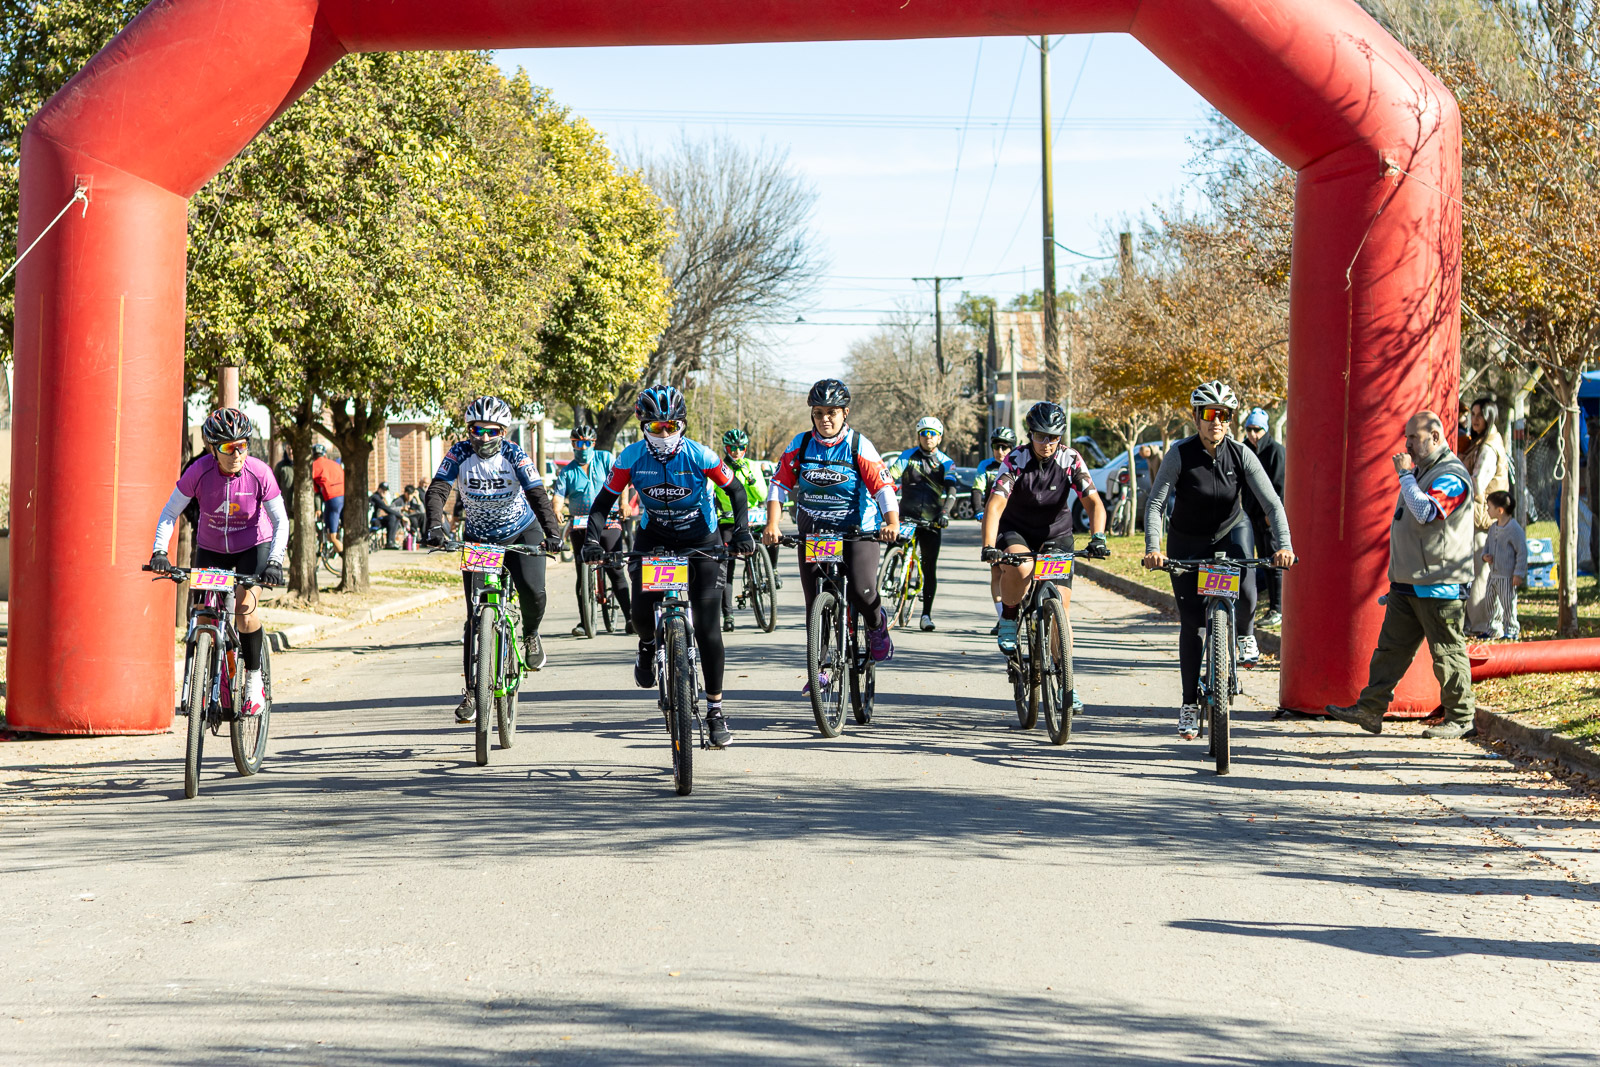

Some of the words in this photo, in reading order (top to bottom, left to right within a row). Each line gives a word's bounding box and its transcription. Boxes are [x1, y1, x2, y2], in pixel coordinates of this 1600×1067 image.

[468, 478, 507, 490] 932
[813, 541, 837, 556] 46
[653, 566, 676, 582] 15
[1041, 561, 1067, 574] 115
[196, 574, 228, 585] 139
[1205, 573, 1233, 590] 86
